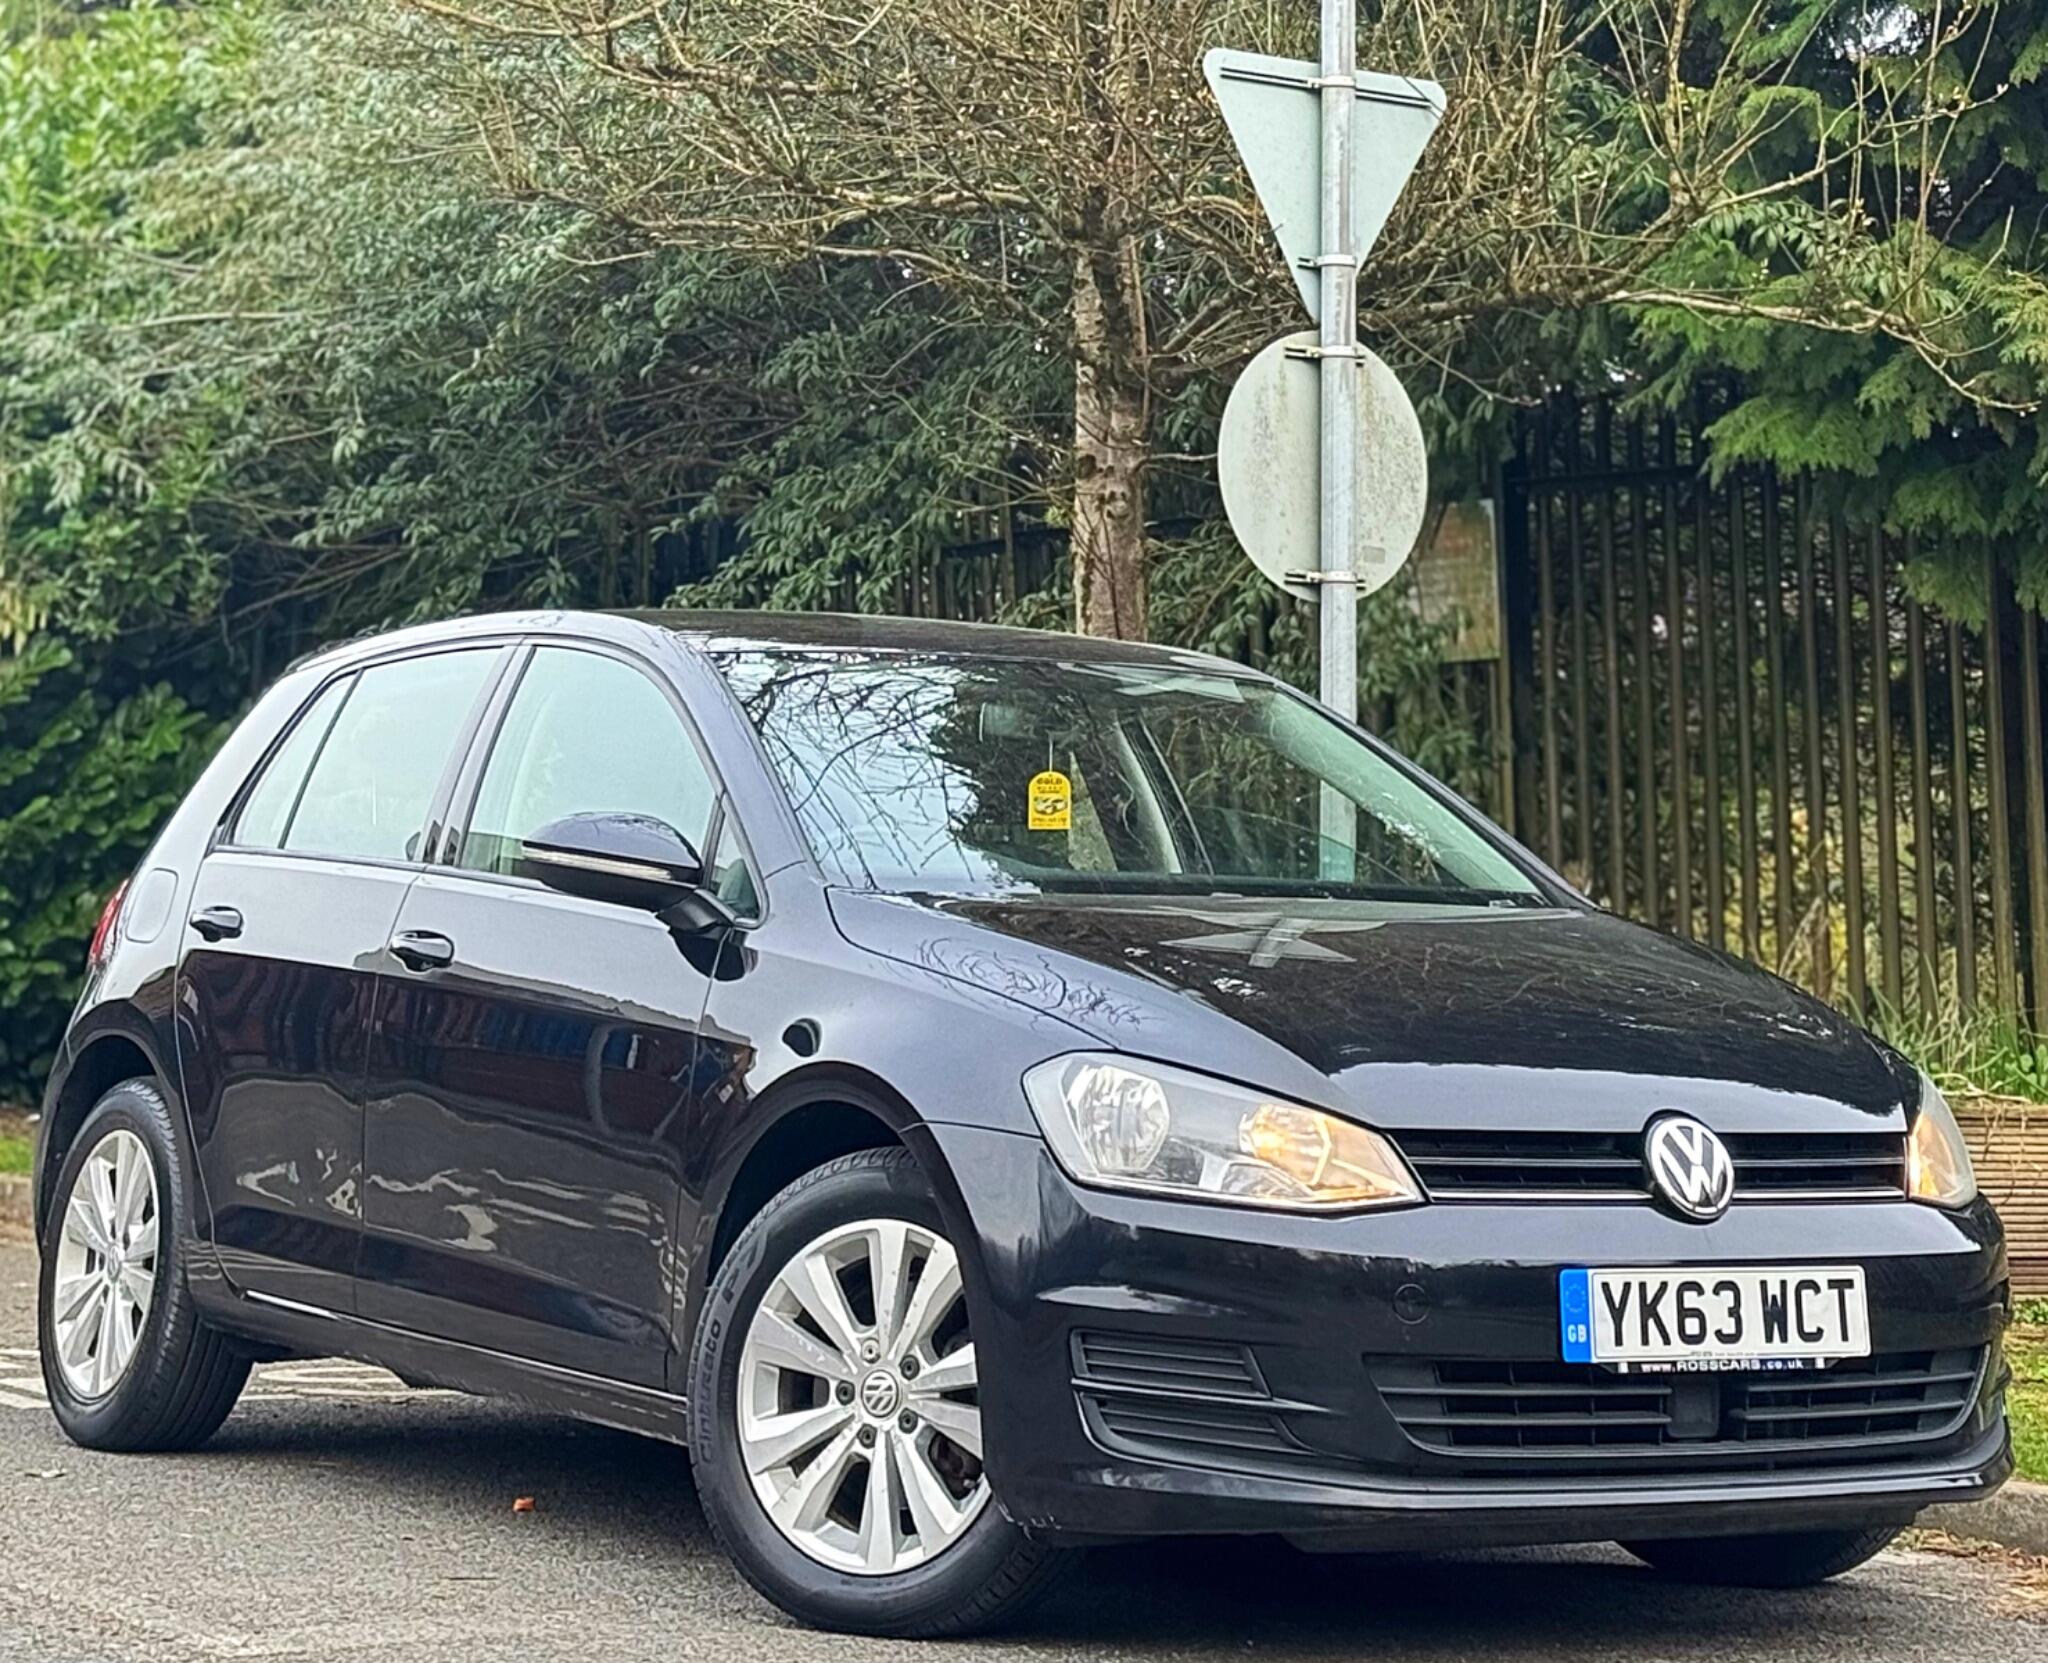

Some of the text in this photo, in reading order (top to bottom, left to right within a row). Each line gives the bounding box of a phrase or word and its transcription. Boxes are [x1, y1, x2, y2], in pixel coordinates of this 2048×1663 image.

[1600, 1278, 1855, 1347] YK63 WCT
[1566, 1324, 1588, 1343] GB
[1640, 1358, 1804, 1373] www.ROSSCARS.co.uk
